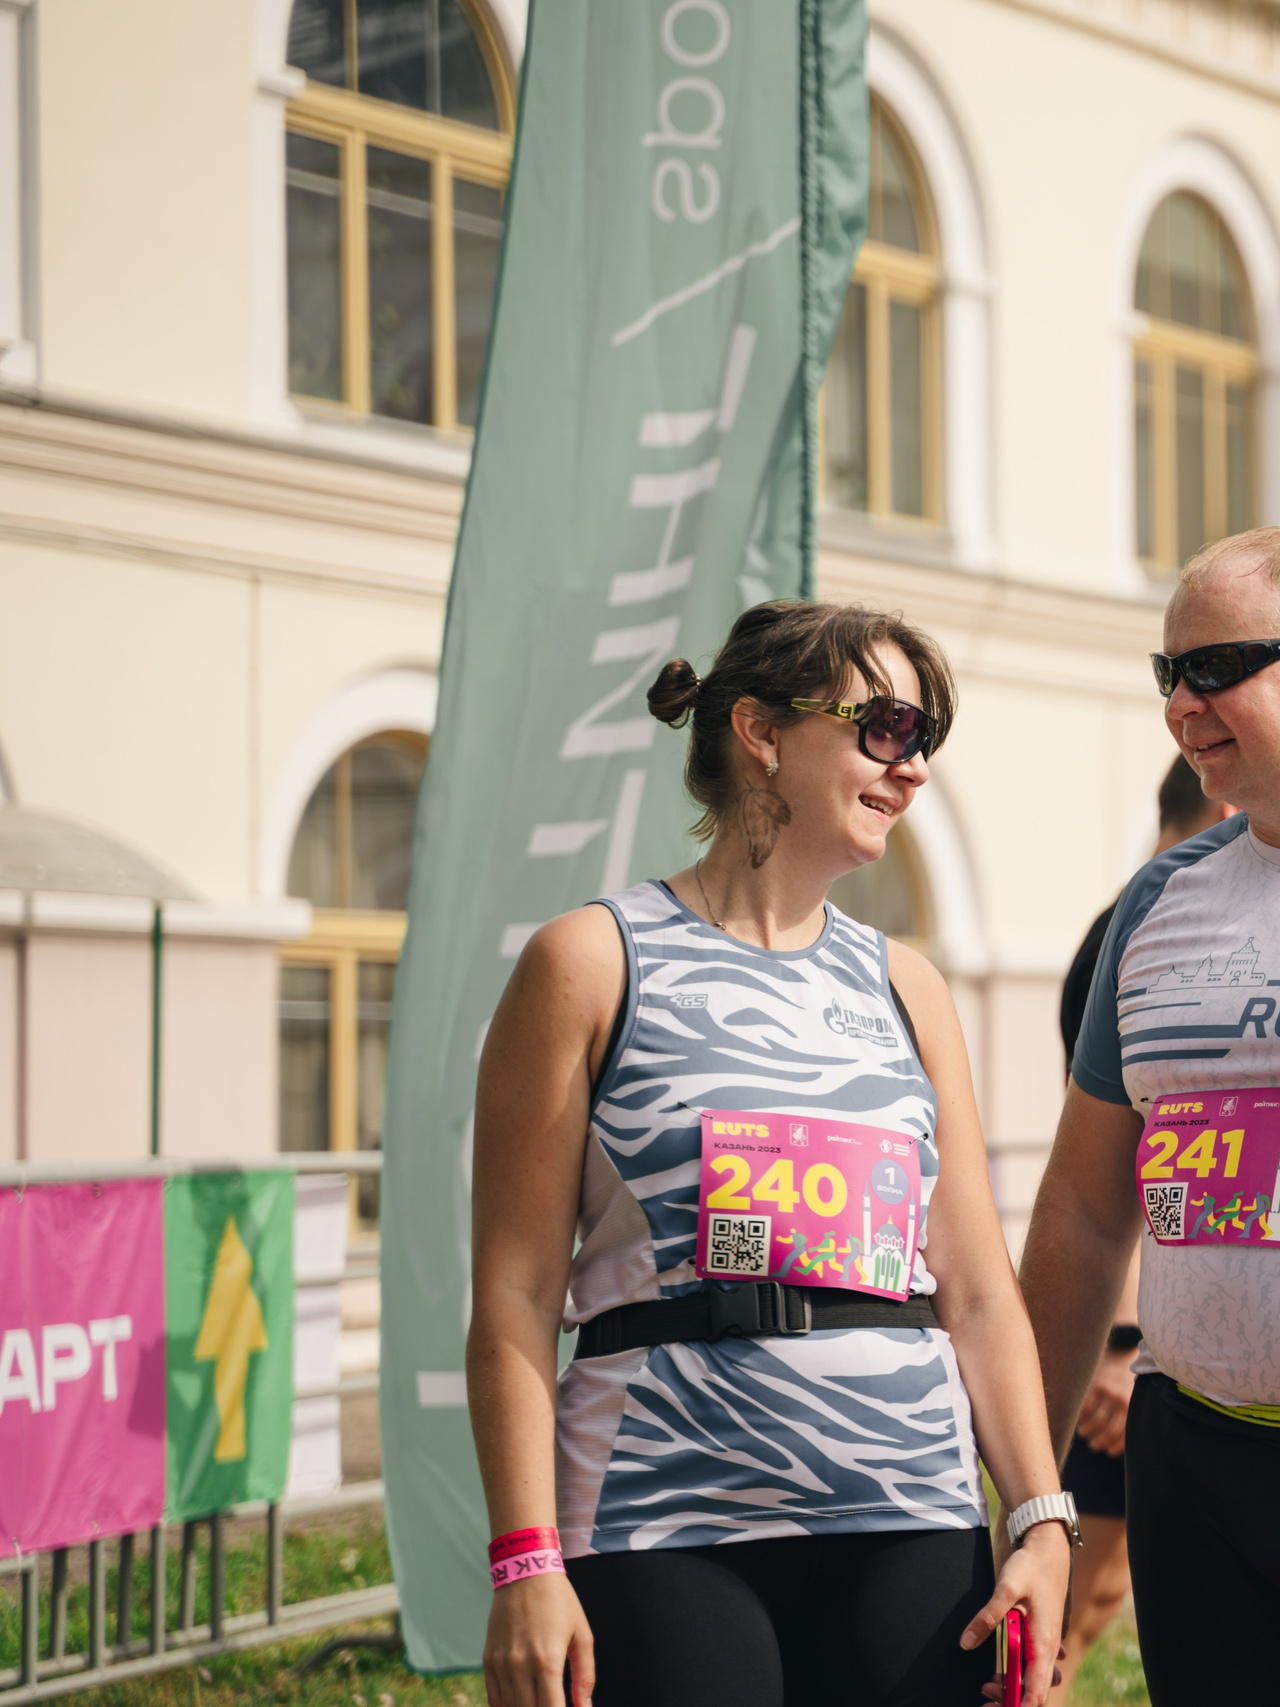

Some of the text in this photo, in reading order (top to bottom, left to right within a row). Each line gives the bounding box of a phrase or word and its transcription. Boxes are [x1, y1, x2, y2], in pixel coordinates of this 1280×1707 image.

[842, 1009, 895, 1035] ГАЗПРОМ
[1157, 1102, 1204, 1116] RUTS
[712, 1121, 770, 1138] RUTS
[1154, 1120, 1188, 1128] КАЗАНЬ
[714, 1142, 782, 1154] КАЗАНЬ 2023
[1140, 1129, 1246, 1179] 241
[884, 1167, 896, 1185] 1
[706, 1154, 848, 1217] 240
[876, 1184, 904, 1196] ВОЛНА
